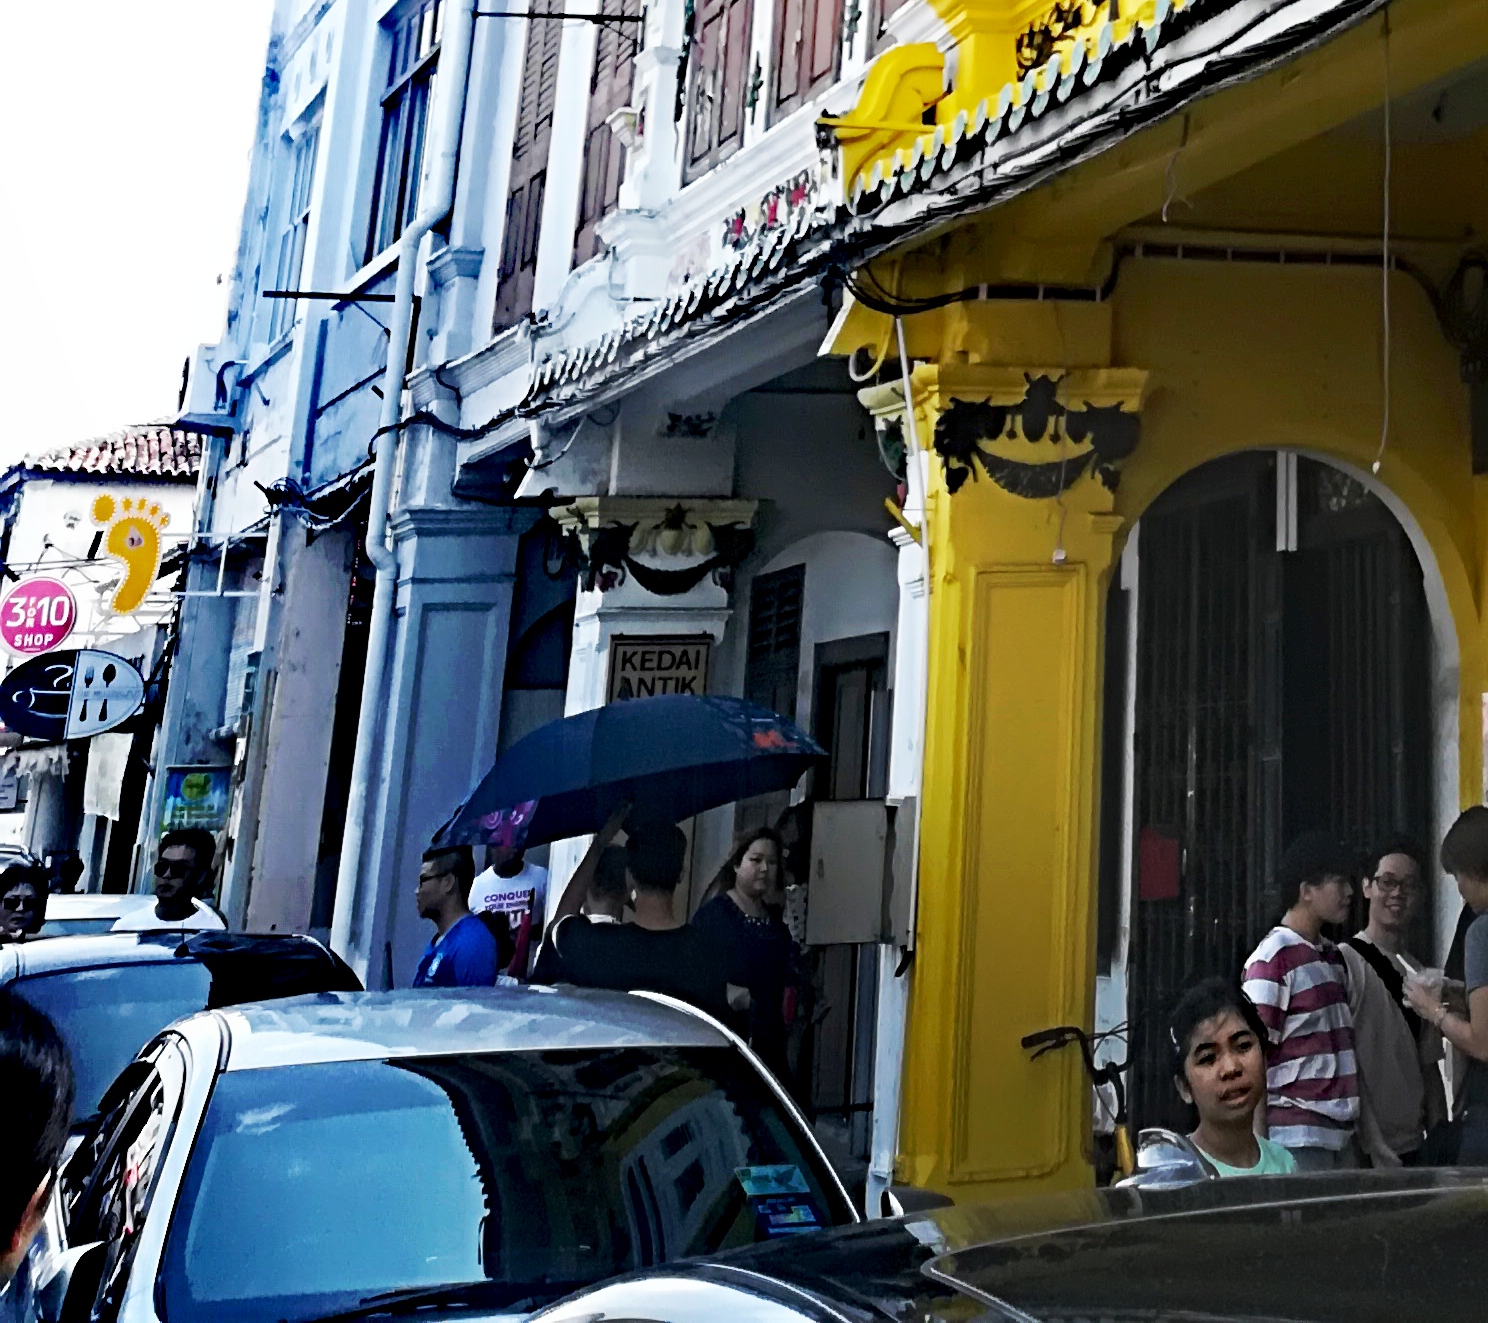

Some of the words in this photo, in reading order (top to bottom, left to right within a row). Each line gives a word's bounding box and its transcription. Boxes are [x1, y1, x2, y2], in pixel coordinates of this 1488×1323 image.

[37, 596, 70, 627] 10
[14, 633, 54, 647] SHOP
[621, 649, 700, 671] KEDAI
[617, 676, 697, 698] ANTIK
